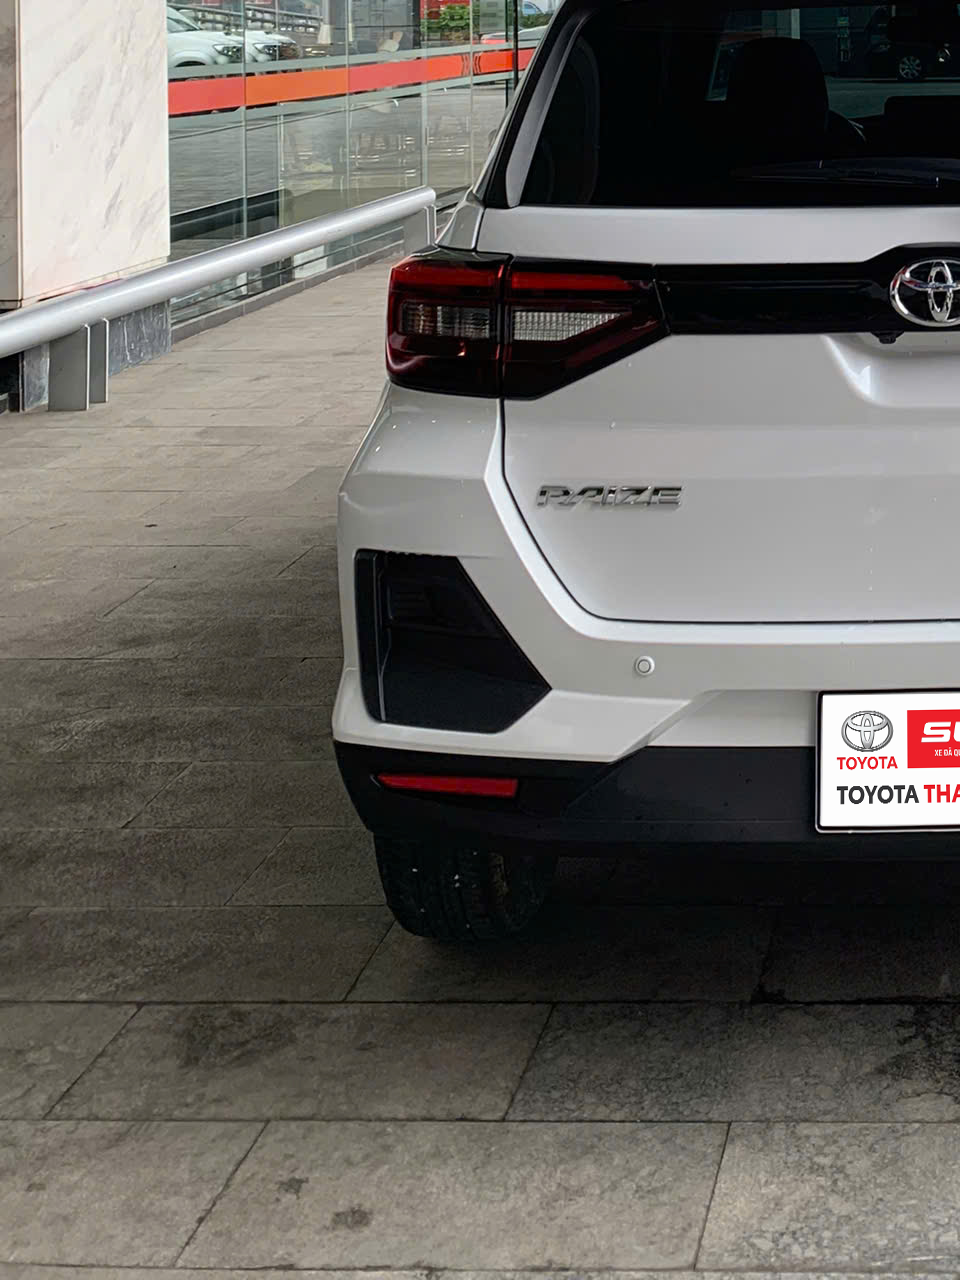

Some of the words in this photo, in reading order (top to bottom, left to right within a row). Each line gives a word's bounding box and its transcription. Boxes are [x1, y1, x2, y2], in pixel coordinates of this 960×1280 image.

[536, 485, 682, 507] RAIZE
[934, 749, 943, 757] XE
[836, 756, 898, 770] TOYOTA
[836, 785, 920, 805] TOYOTA
